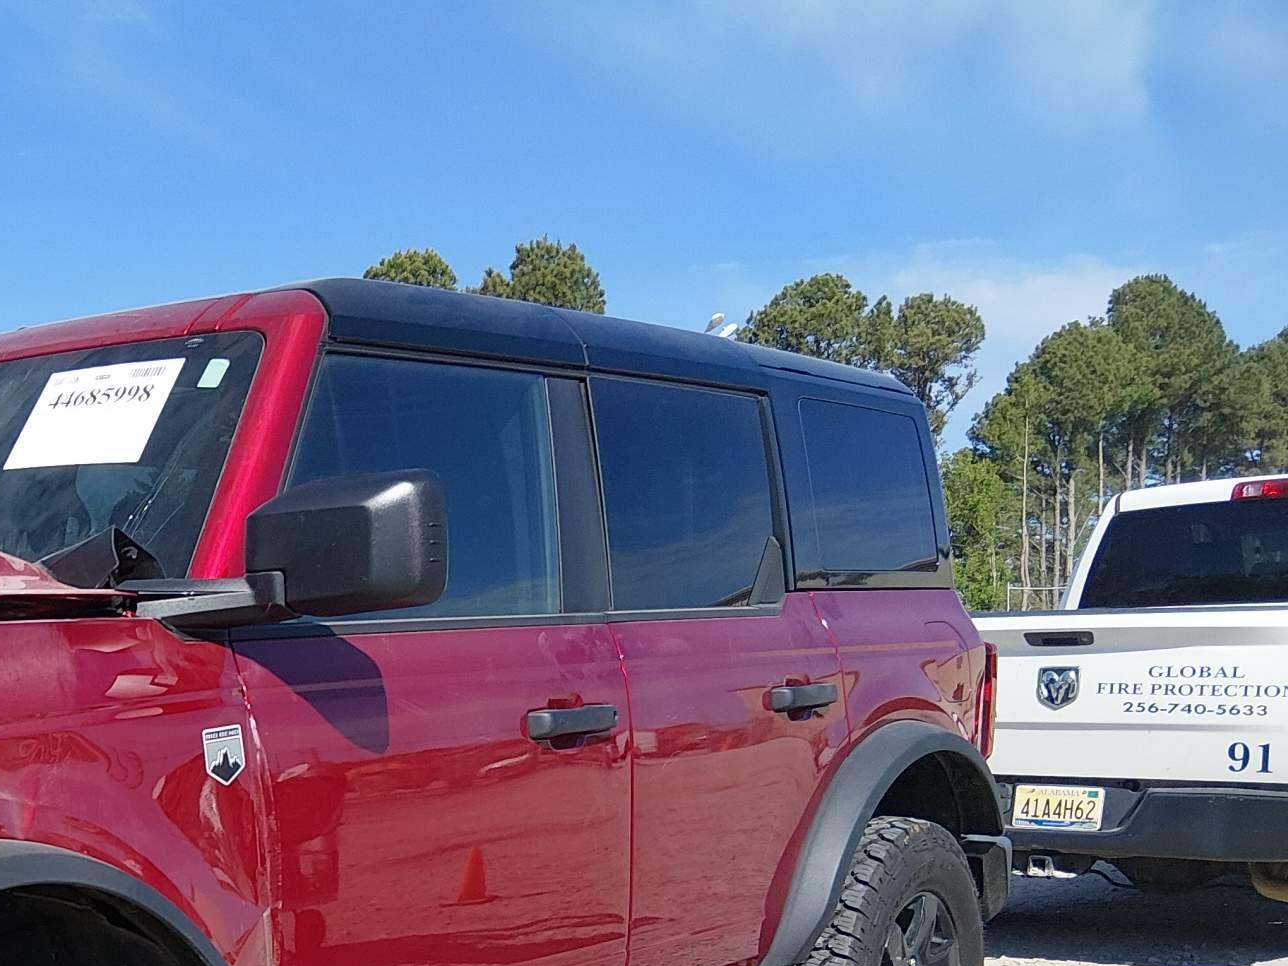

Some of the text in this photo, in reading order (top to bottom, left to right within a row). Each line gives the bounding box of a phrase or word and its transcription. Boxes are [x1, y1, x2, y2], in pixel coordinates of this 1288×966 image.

[49, 384, 154, 409] 44685998
[1148, 665, 1245, 679] GLOBAL
[1096, 682, 1143, 695] FIRE
[1122, 701, 1268, 717] 256-740-5633
[1227, 741, 1273, 774] 91
[1020, 797, 1096, 821] 41A4H62
